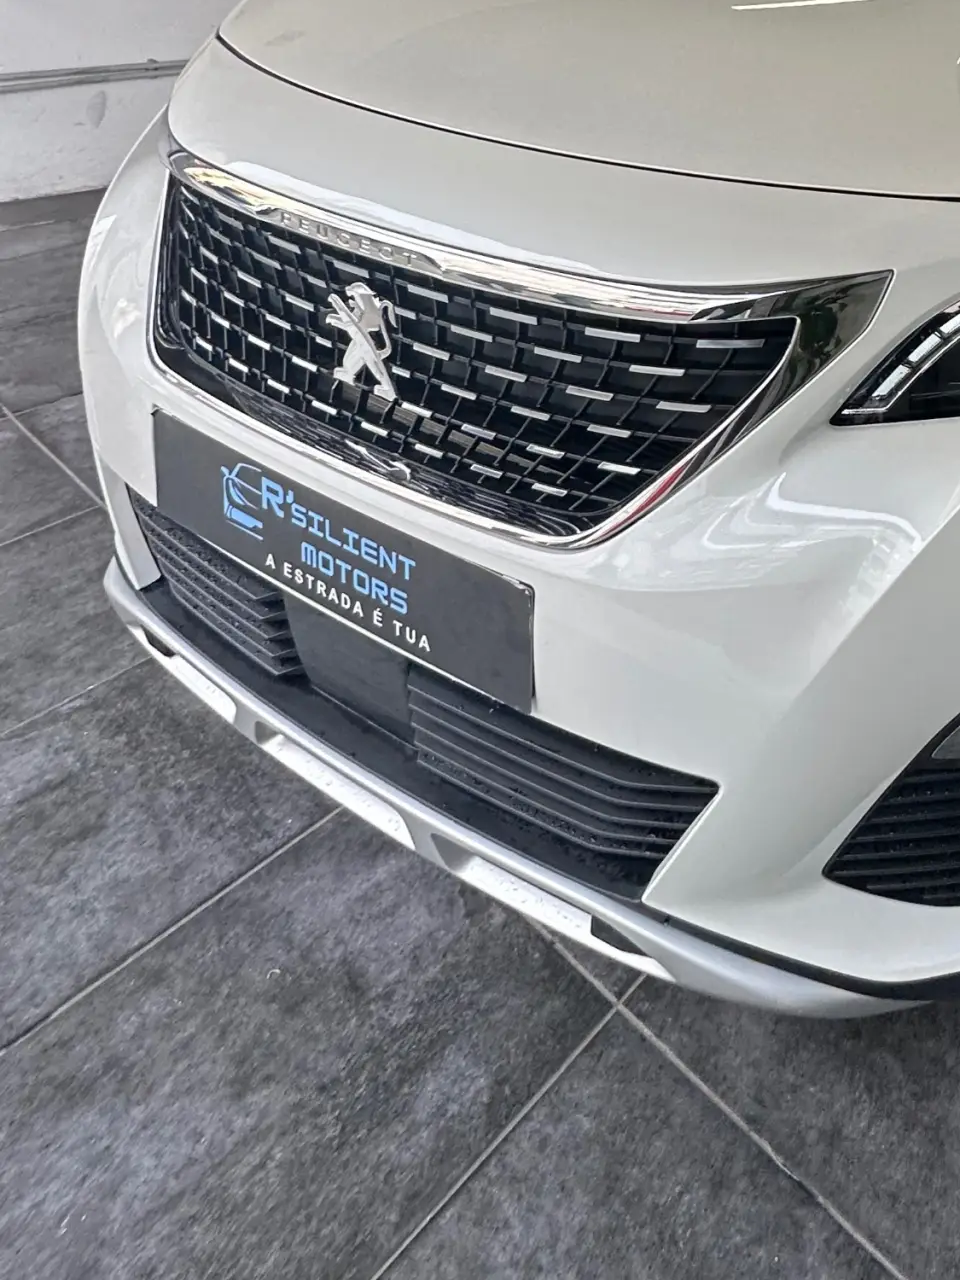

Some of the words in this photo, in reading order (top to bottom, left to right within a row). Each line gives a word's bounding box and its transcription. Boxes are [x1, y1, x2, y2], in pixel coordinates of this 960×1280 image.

[280, 212, 418, 267] PEUGEOT
[260, 475, 416, 582] R'SILIENT
[265, 554, 276, 569] A
[283, 562, 364, 617] ESTRADA
[373, 606, 383, 627] É
[394, 620, 431, 652] TUA
[301, 541, 408, 615] MOTORS
